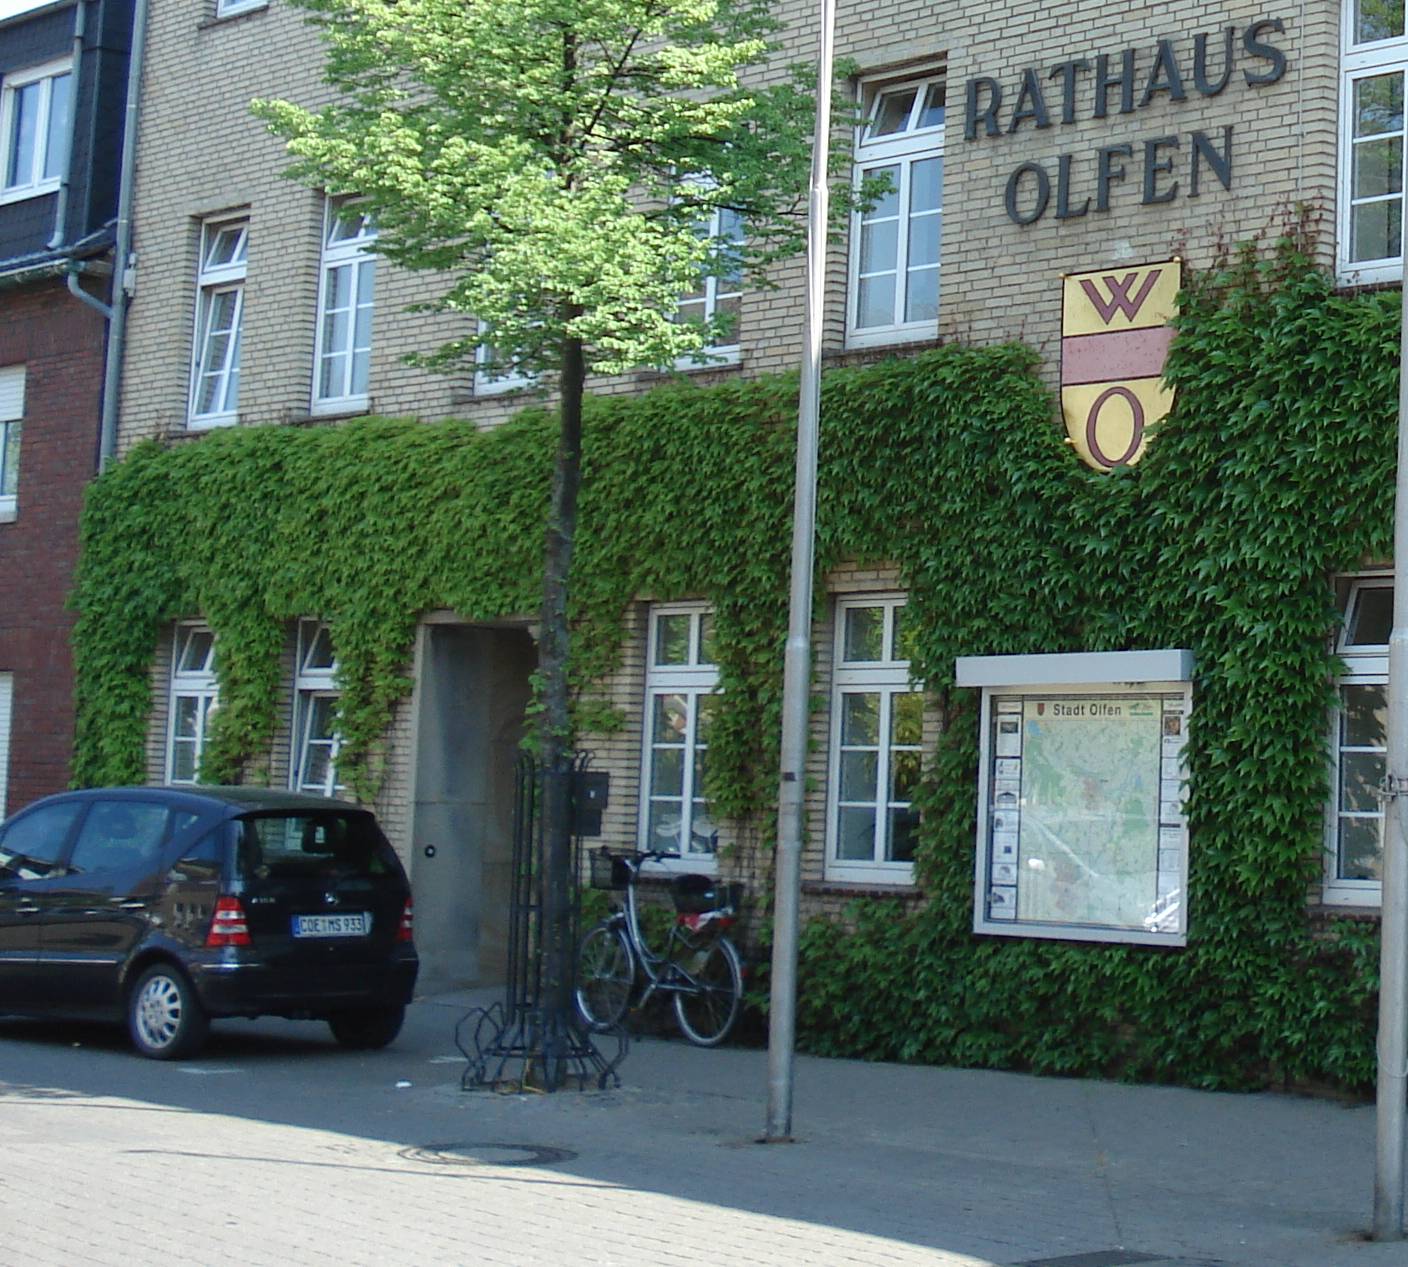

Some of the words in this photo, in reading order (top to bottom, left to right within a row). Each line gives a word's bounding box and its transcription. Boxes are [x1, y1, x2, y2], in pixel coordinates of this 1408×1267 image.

[964, 16, 1287, 141] RATHAUS
[1004, 124, 1234, 226] OLFEN
[1078, 268, 1163, 326] W
[1053, 703, 1085, 717] Stadt
[1089, 703, 1122, 716] Olfen
